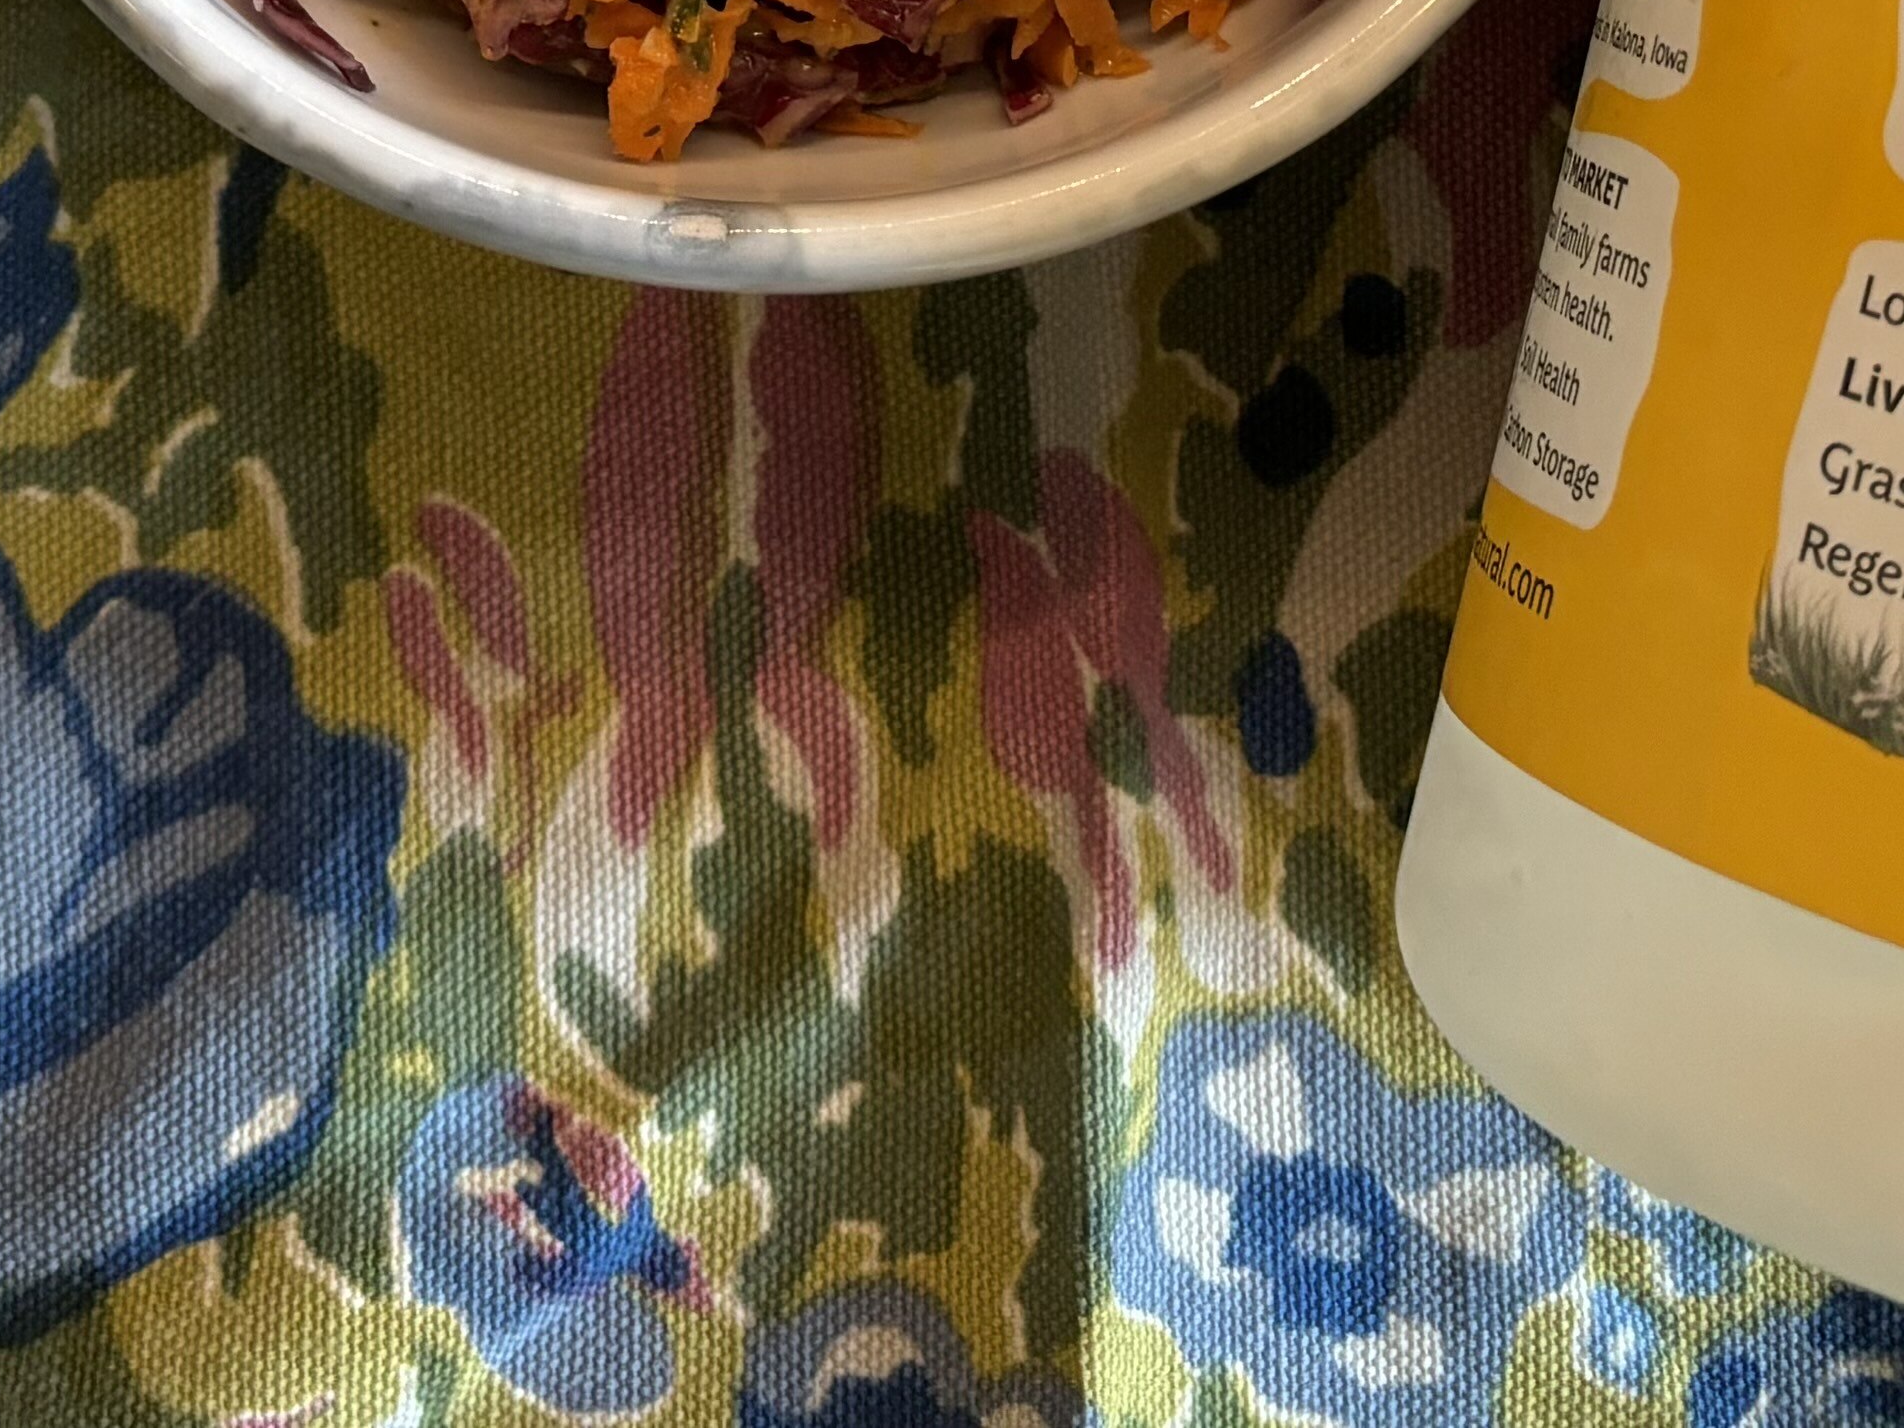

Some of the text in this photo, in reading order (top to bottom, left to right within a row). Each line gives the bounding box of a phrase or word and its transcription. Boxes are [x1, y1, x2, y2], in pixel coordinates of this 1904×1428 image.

[1650, 34, 1688, 74] Iowa
[1570, 153, 1629, 210] MARKET
[1555, 211, 1595, 270] family
[1593, 233, 1651, 289] farms
[1560, 280, 1613, 342] health.
[1533, 351, 1580, 406] Health
[1532, 431, 1599, 502] Storage
